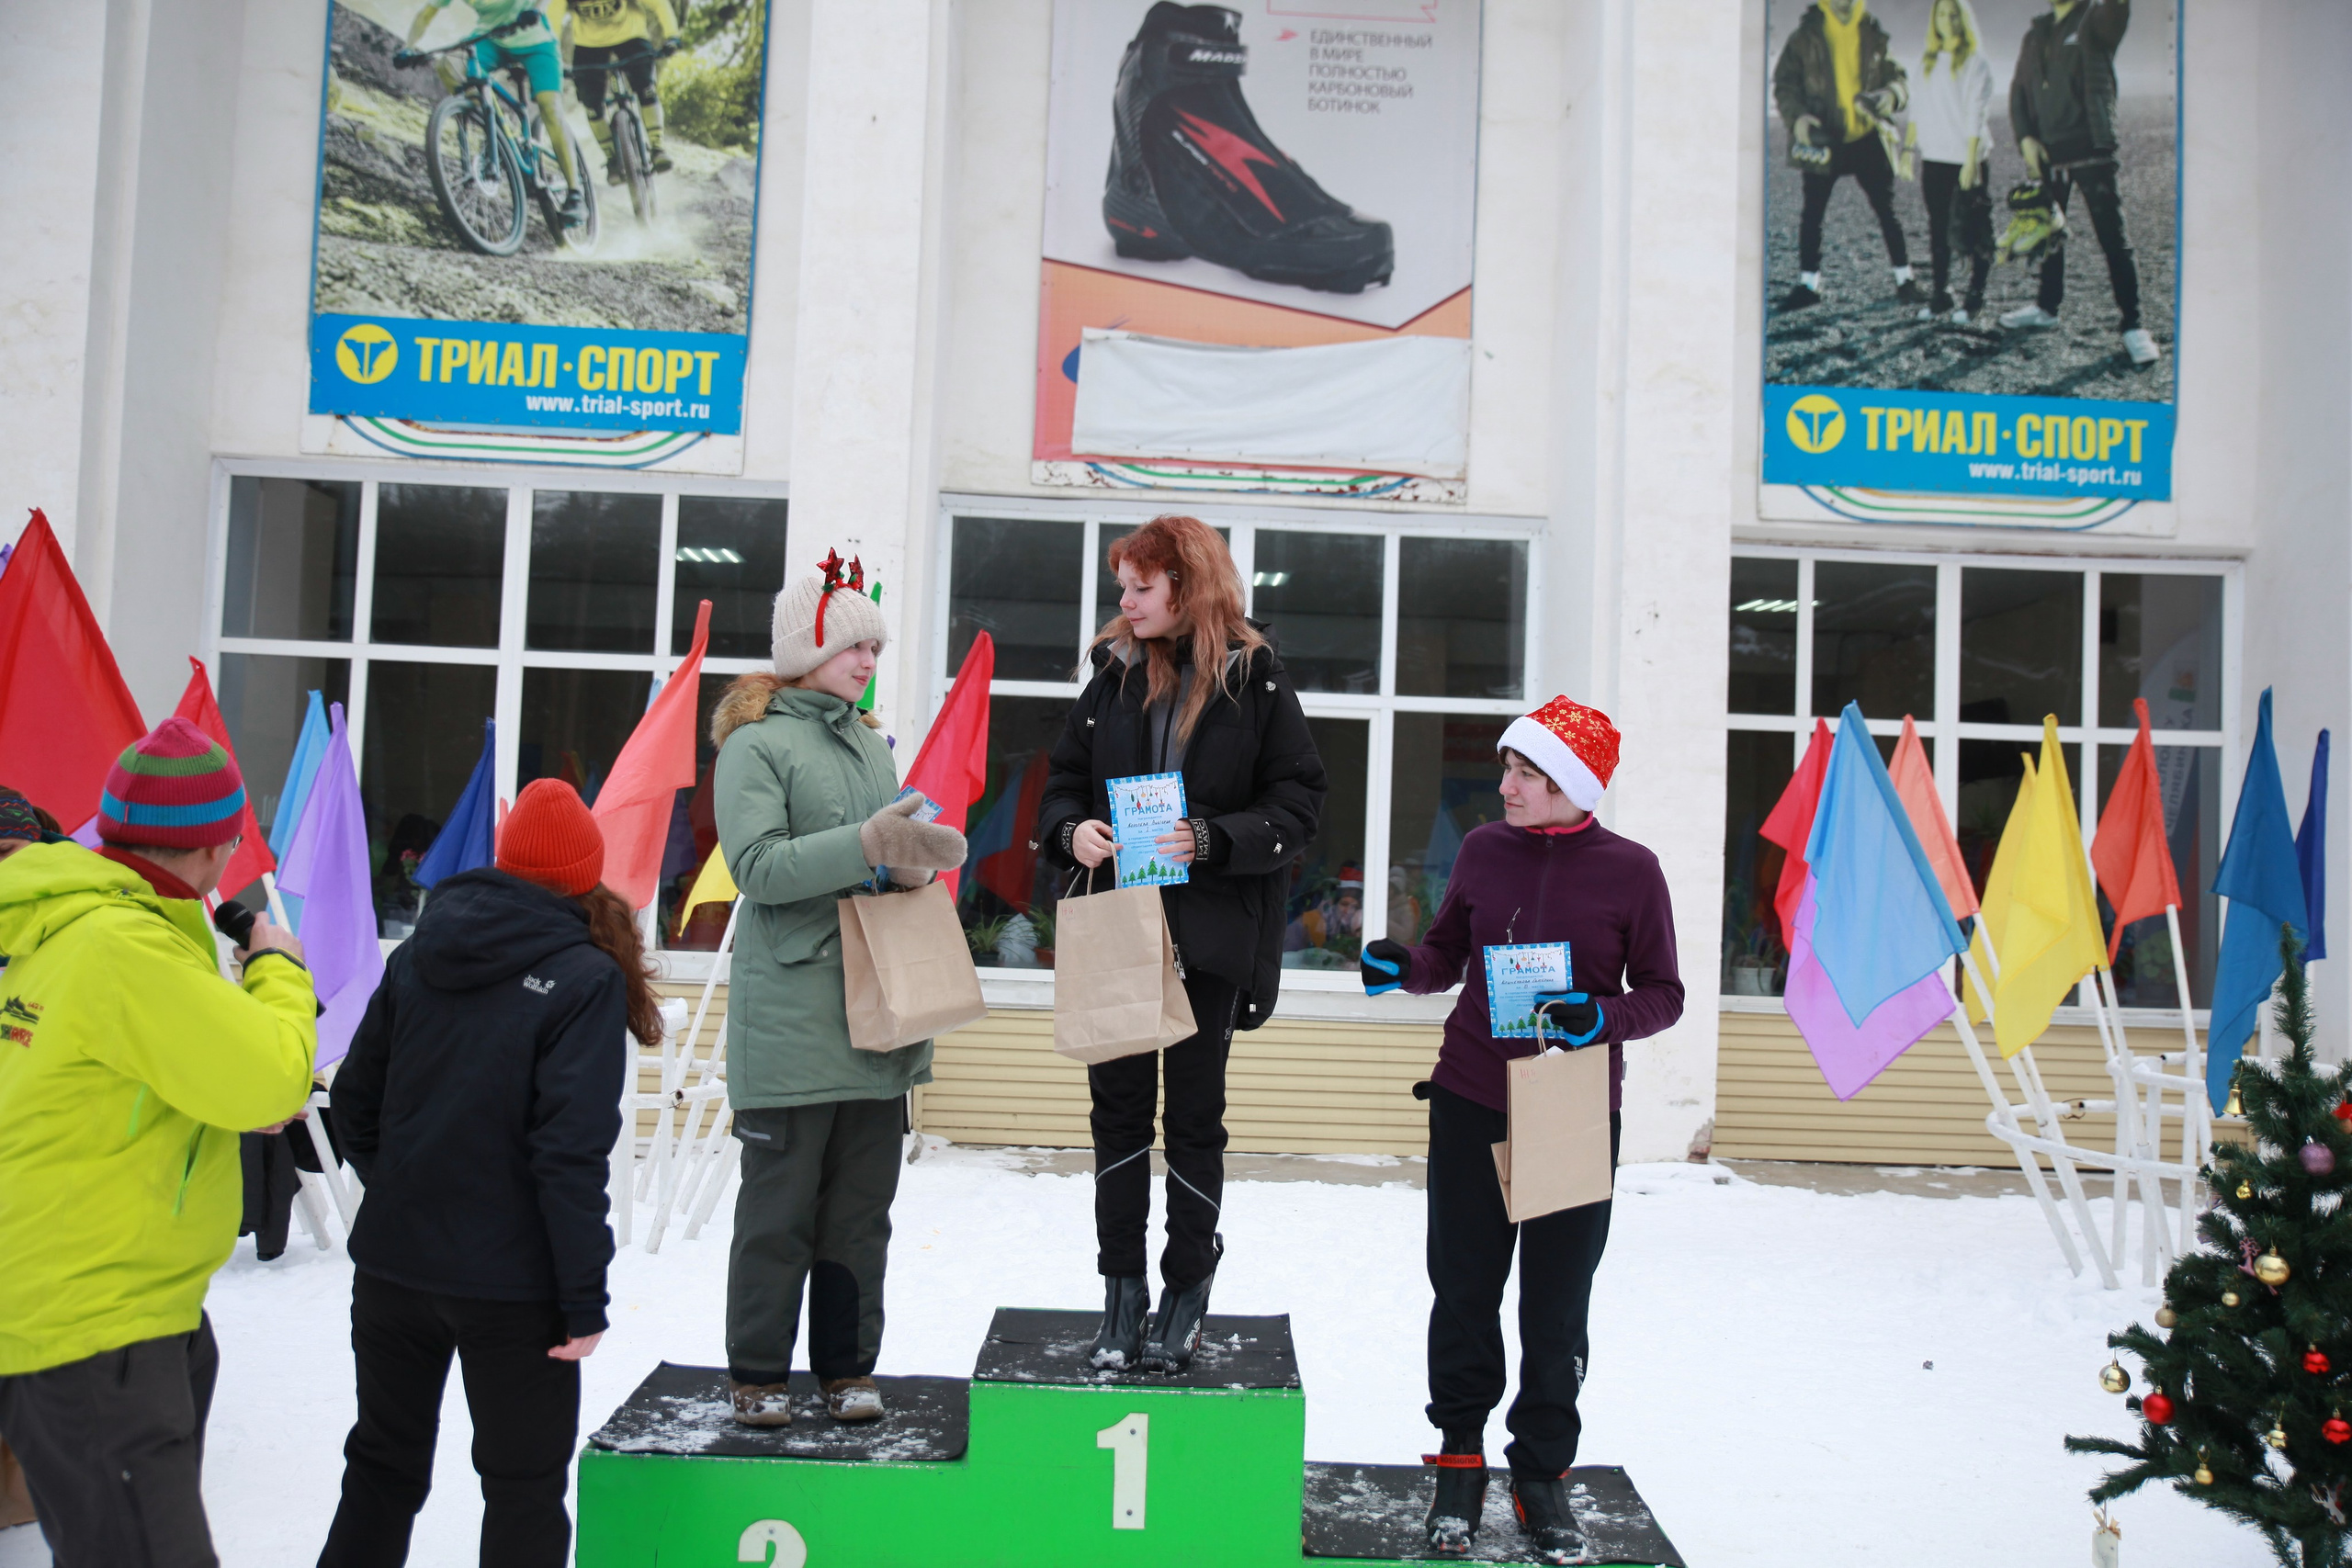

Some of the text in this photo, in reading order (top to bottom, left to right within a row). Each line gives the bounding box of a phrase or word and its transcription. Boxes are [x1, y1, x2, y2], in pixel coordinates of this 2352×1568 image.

[1310, 28, 1433, 48] ЕДИНСТВЕННЫЙ
[1309, 48, 1363, 62] В МИРЕ
[1308, 63, 1407, 82] ПОЛНОСТЬЮ
[1308, 81, 1414, 98] КАРБОНОВЫЙ
[1307, 97, 1381, 114] БОТИНОК
[526, 394, 710, 420] www.trial-sport.ru
[1968, 462, 2142, 486] www.trial-sport.ru
[1125, 804, 1173, 817] ГРАМОТА
[1501, 965, 1555, 976] ГРАМОТА
[523, 980, 548, 994] Wolfskin
[525, 975, 541, 986] Jack
[1183, 1318, 1201, 1351] SPINE
[1574, 1355, 1585, 1391] FILA
[1096, 1413, 1148, 1529] 1
